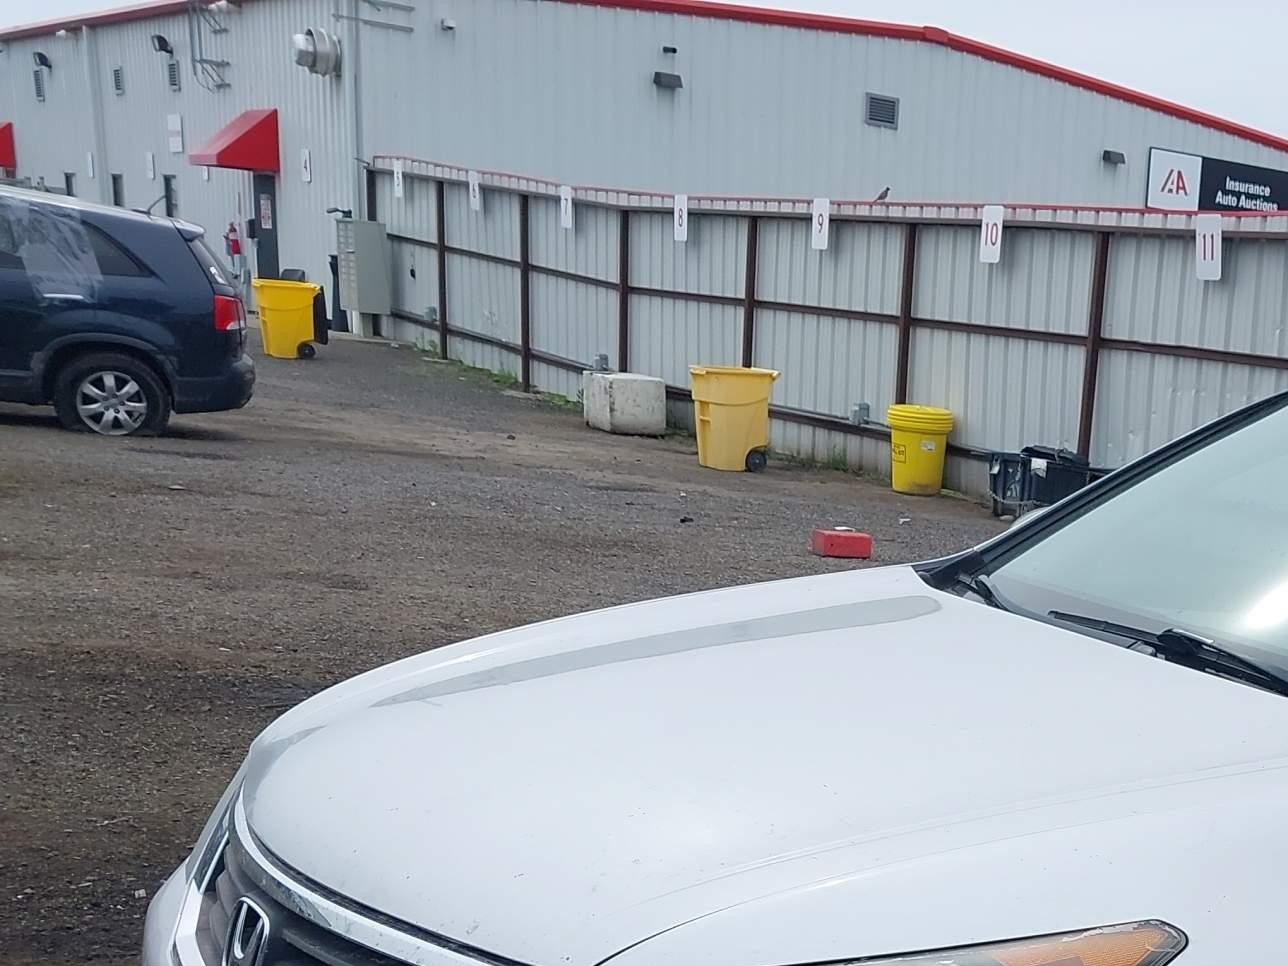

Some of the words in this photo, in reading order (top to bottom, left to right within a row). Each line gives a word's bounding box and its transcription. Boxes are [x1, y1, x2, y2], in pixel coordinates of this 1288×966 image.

[1225, 176, 1271, 197] Insurance
[563, 198, 569, 217] 7
[1215, 190, 1237, 208] Auto
[1238, 194, 1279, 212] Auctions
[678, 207, 684, 227] 8
[817, 213, 824, 234] 9
[984, 222, 999, 247] 10
[1201, 233, 1216, 263] 11
